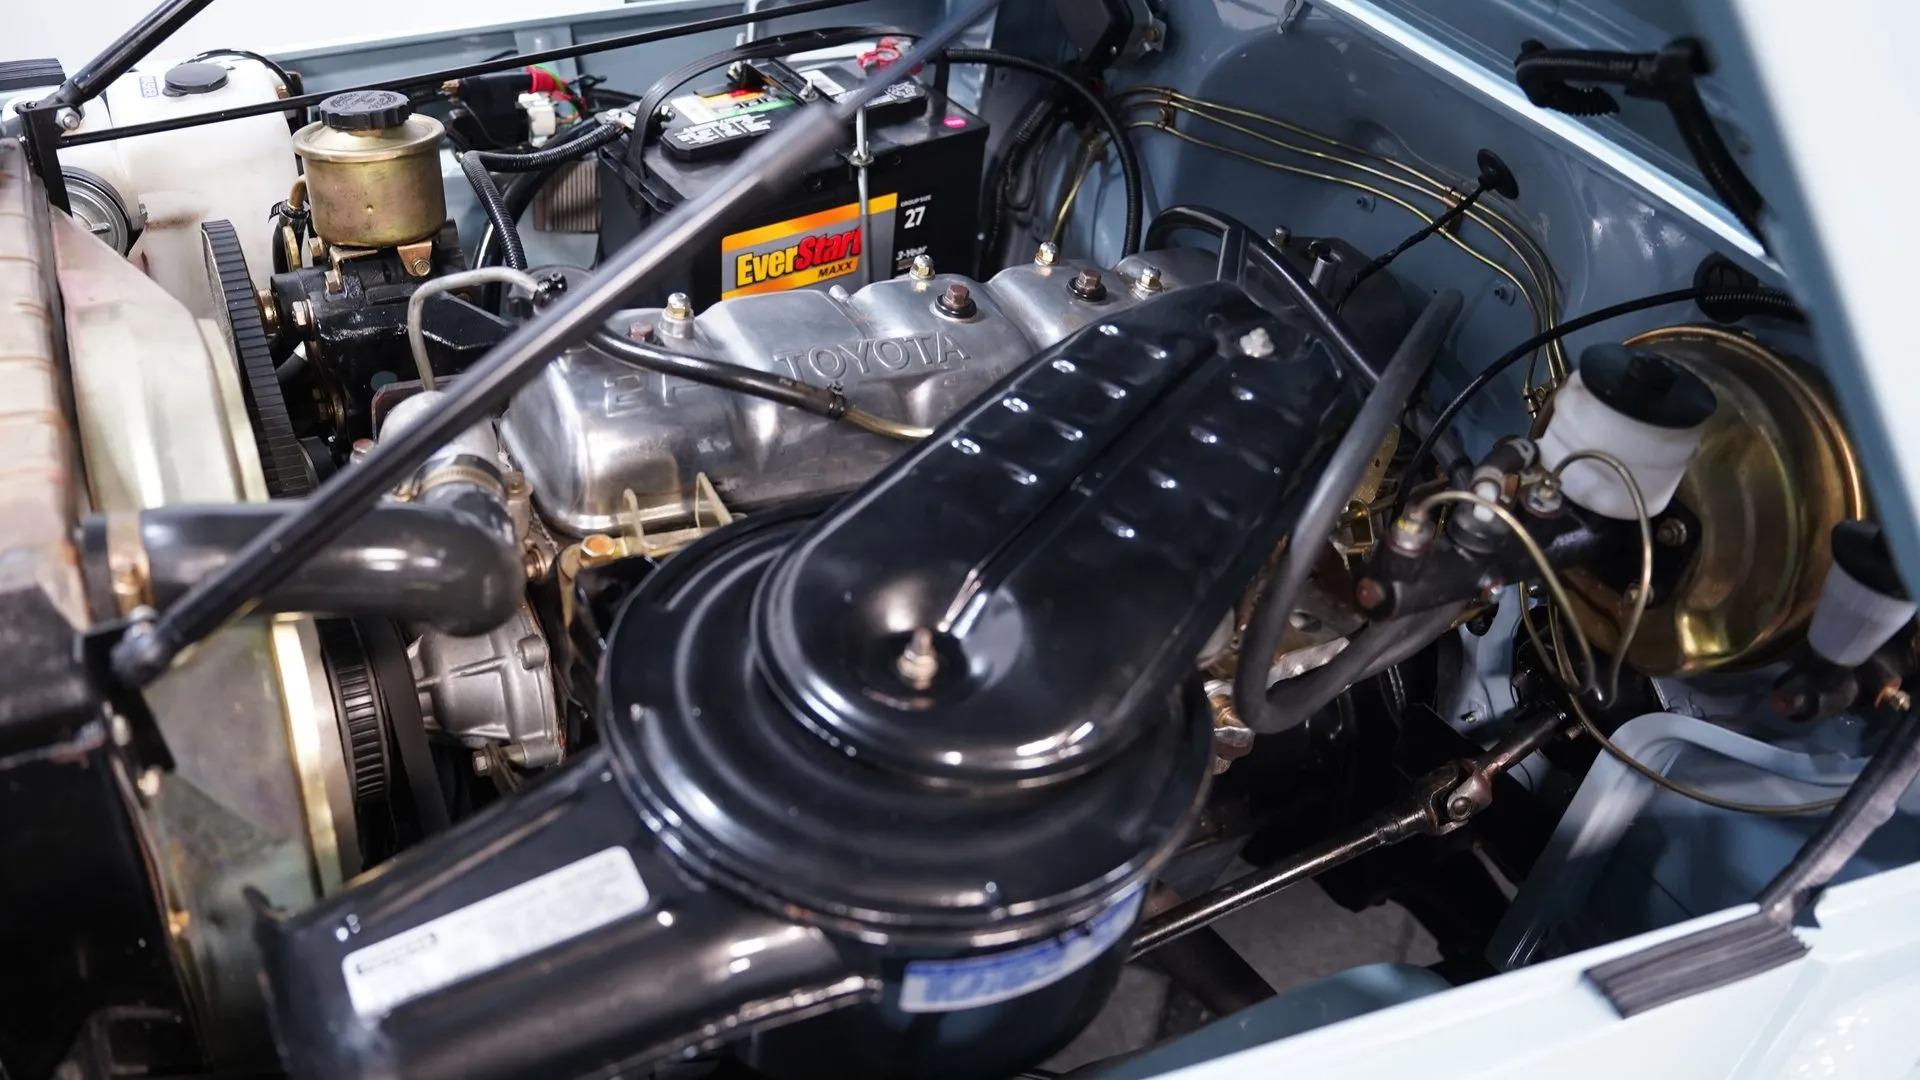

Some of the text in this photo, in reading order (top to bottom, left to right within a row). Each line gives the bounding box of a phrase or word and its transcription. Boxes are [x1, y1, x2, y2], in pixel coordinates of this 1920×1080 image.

[904, 205, 926, 229] 27
[736, 225, 863, 288] EverStart
[818, 260, 853, 279] MAXX
[772, 331, 972, 383] TOYOTA
